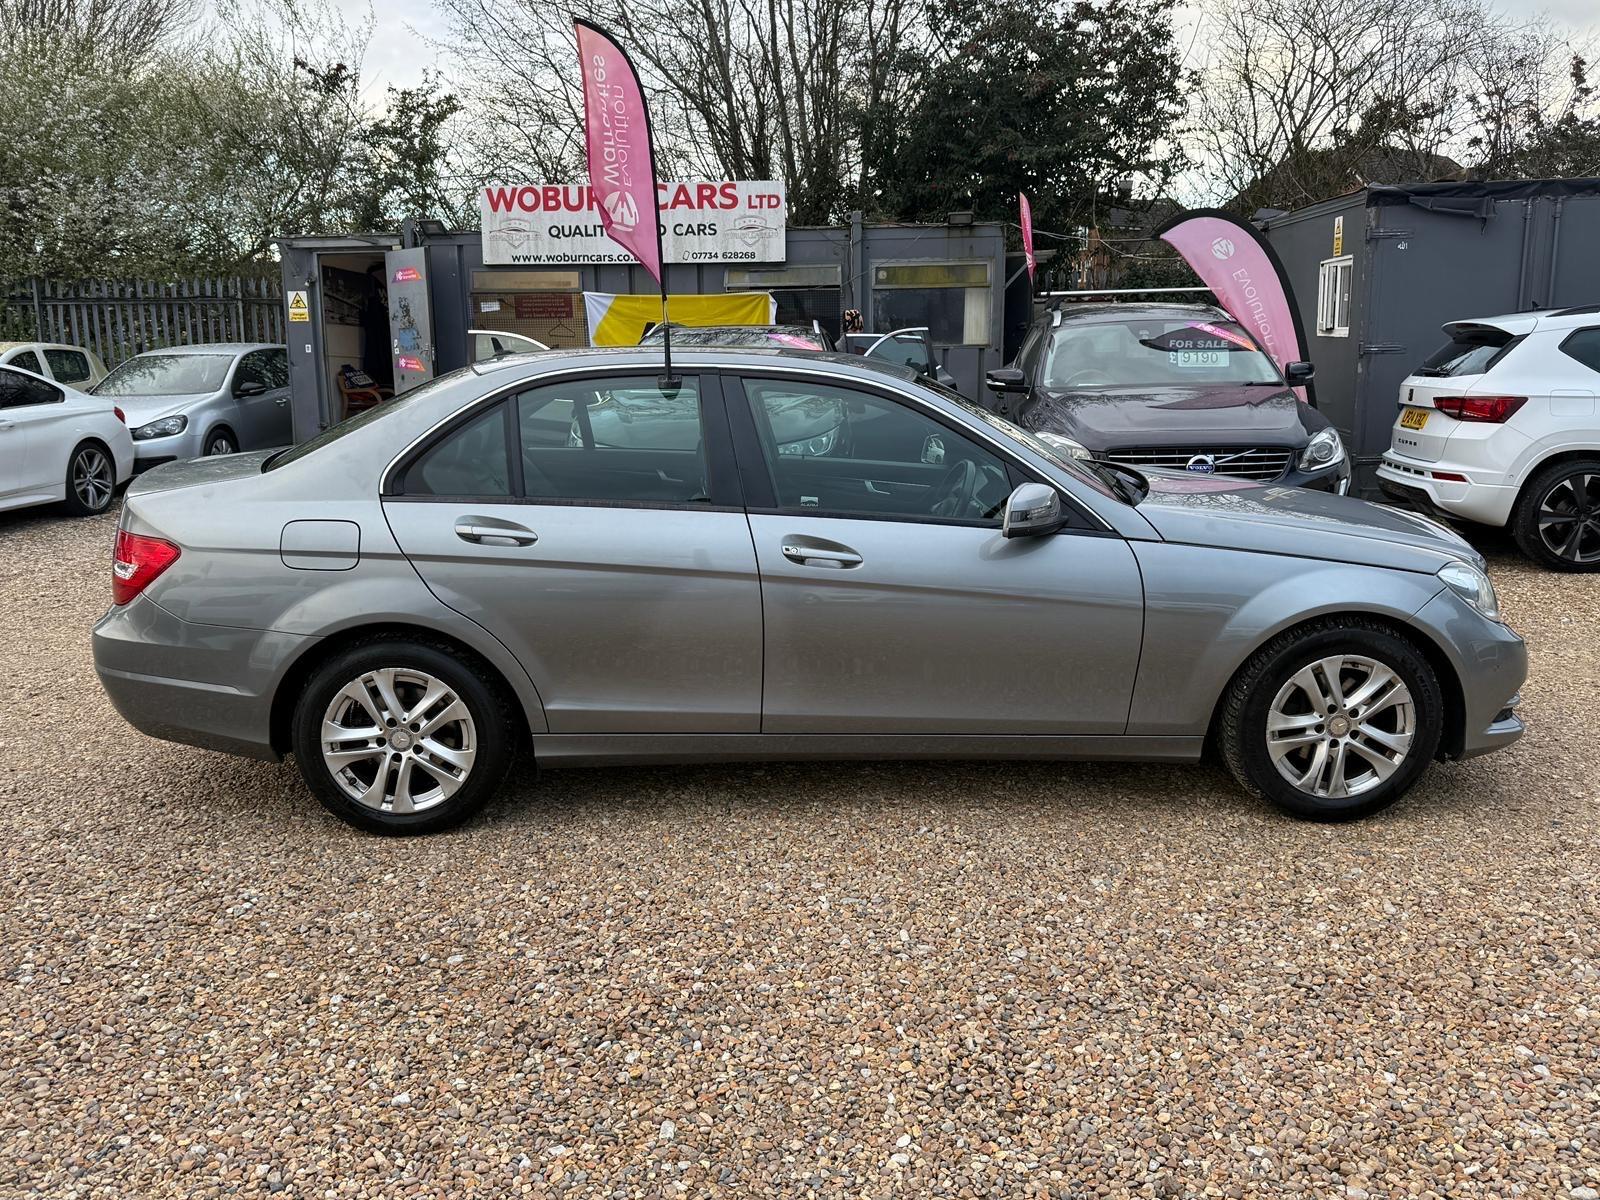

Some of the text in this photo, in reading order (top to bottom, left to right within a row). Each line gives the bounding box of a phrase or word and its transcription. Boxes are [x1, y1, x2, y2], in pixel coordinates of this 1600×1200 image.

[486, 186, 601, 212] WOBUR
[748, 194, 780, 209] LTD
[548, 225, 605, 239] QUALIT
[673, 223, 717, 236] CARS
[511, 253, 639, 263] www.woburncars.co.u
[692, 252, 756, 260] 07734 628268
[1169, 340, 1229, 348] FOR SALE
[1183, 351, 1219, 363] 9190
